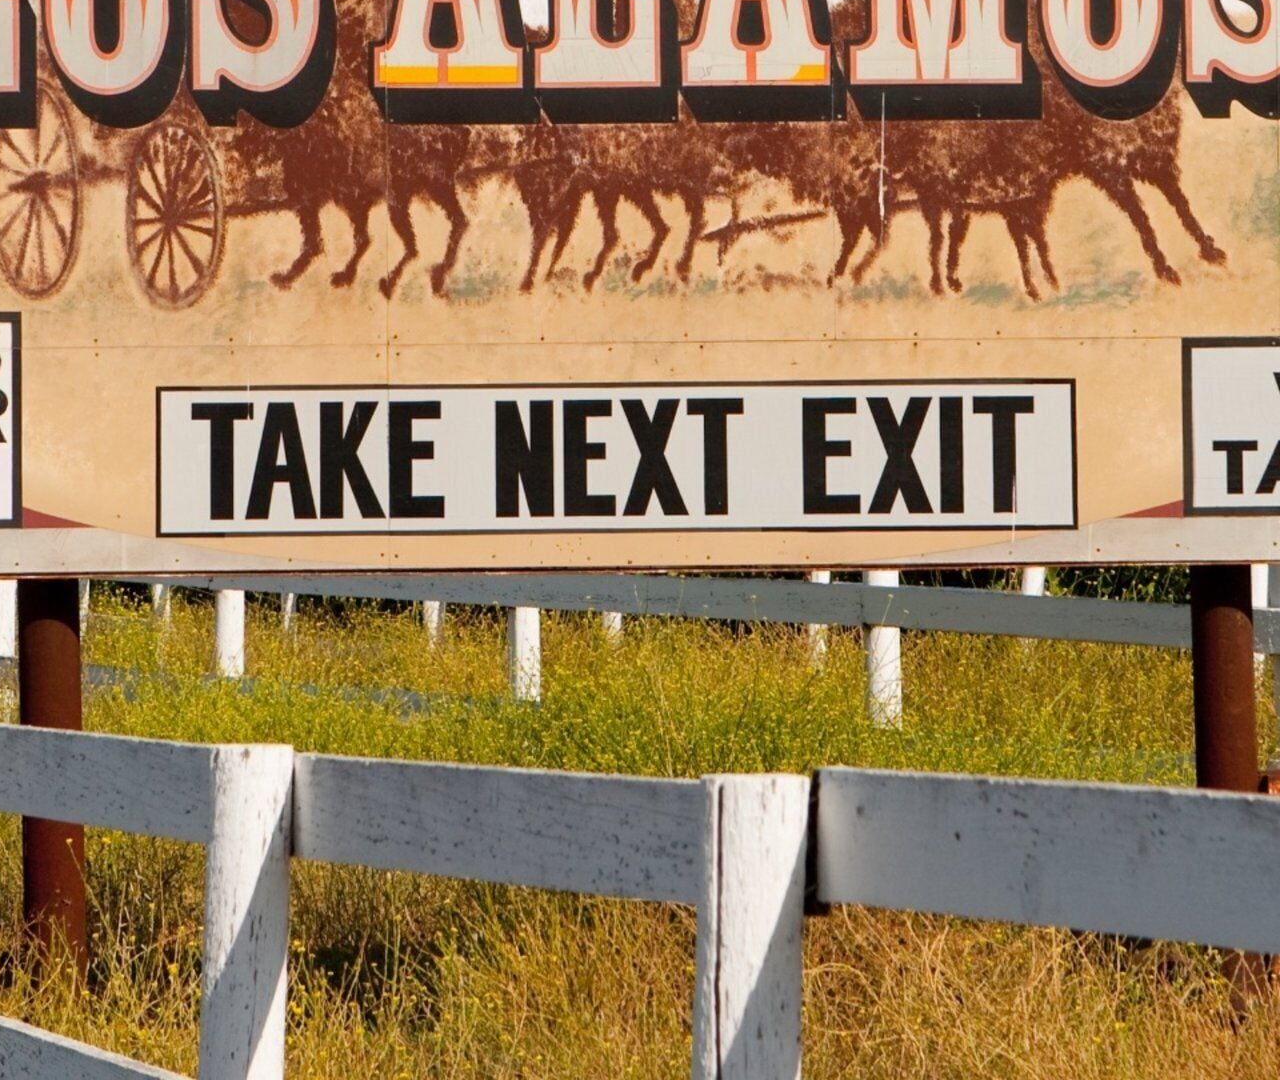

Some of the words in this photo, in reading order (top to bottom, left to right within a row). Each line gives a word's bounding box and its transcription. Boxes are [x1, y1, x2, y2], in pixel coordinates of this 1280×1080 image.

[191, 400, 445, 520] TAKE
[496, 398, 744, 518] NEXT
[802, 395, 1034, 515] EXIT
